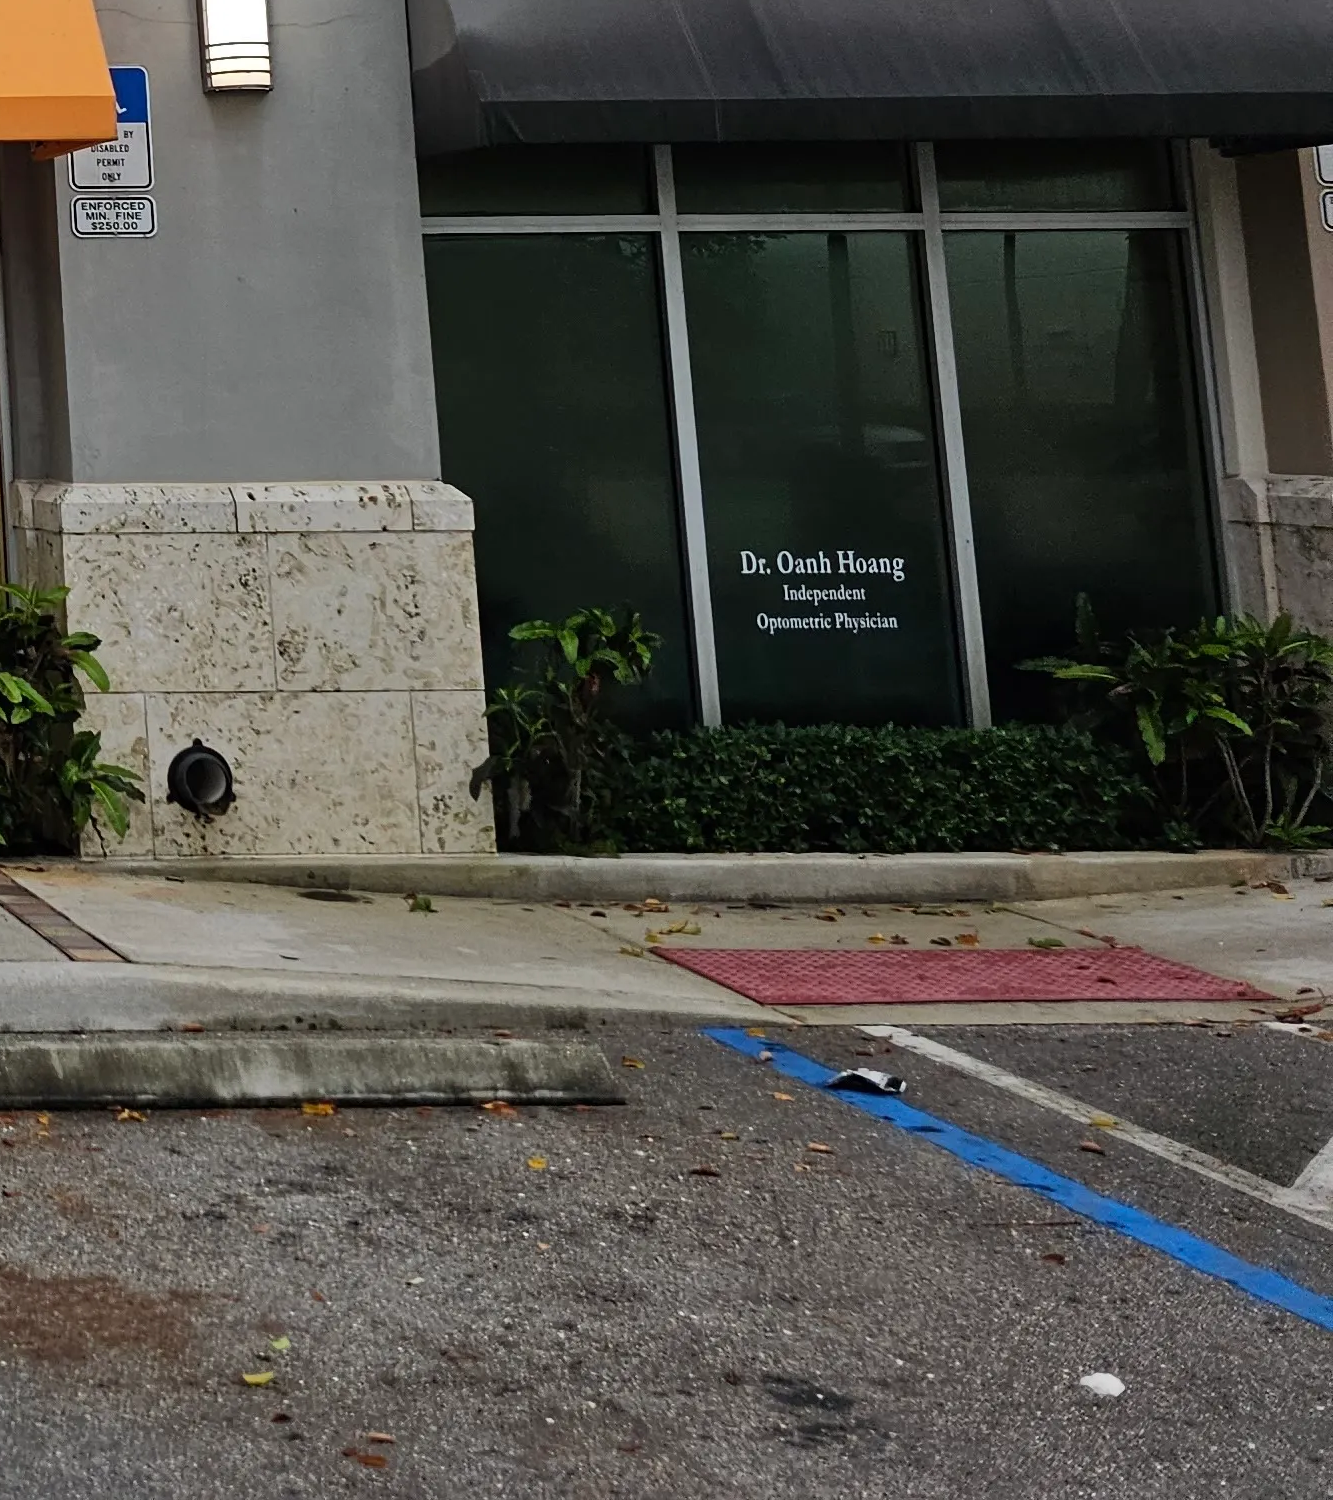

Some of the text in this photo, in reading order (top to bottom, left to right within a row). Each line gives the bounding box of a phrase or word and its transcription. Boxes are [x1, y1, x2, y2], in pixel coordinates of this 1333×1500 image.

[123, 130, 134, 139] BY
[96, 158, 126, 168] PERMIT
[101, 172, 122, 182] ONLY
[81, 201, 146, 211] ENFORCED
[85, 211, 142, 221] MIN. FINE
[90, 221, 139, 231] $250.00
[739, 550, 906, 582] Dr. Oanh Hoang
[782, 584, 867, 607] Independent
[756, 611, 899, 635] Optometric Physician
